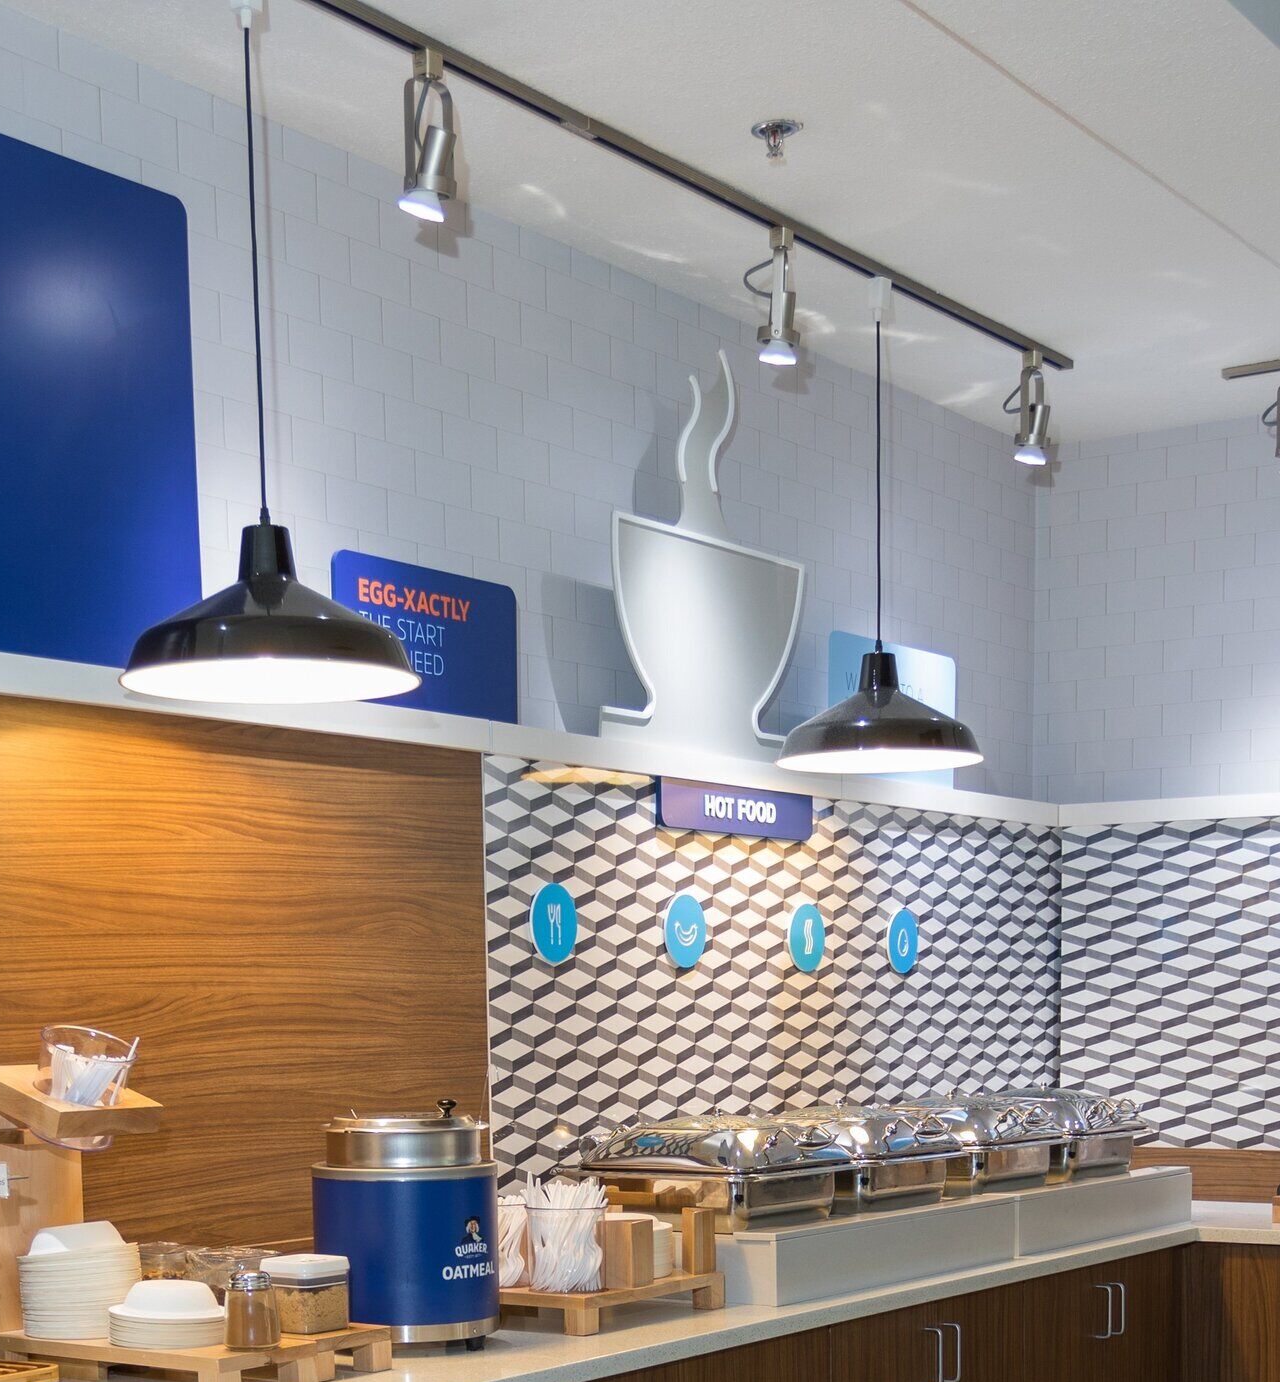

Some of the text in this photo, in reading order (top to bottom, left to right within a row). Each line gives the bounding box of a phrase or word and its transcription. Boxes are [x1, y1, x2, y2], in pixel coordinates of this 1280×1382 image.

[358, 577, 471, 622] EGG-XACTLY
[397, 618, 445, 647] START
[704, 794, 776, 824] HOT FOOD
[455, 1243, 488, 1257] QUAKER
[442, 1261, 495, 1280] OATMEAL
